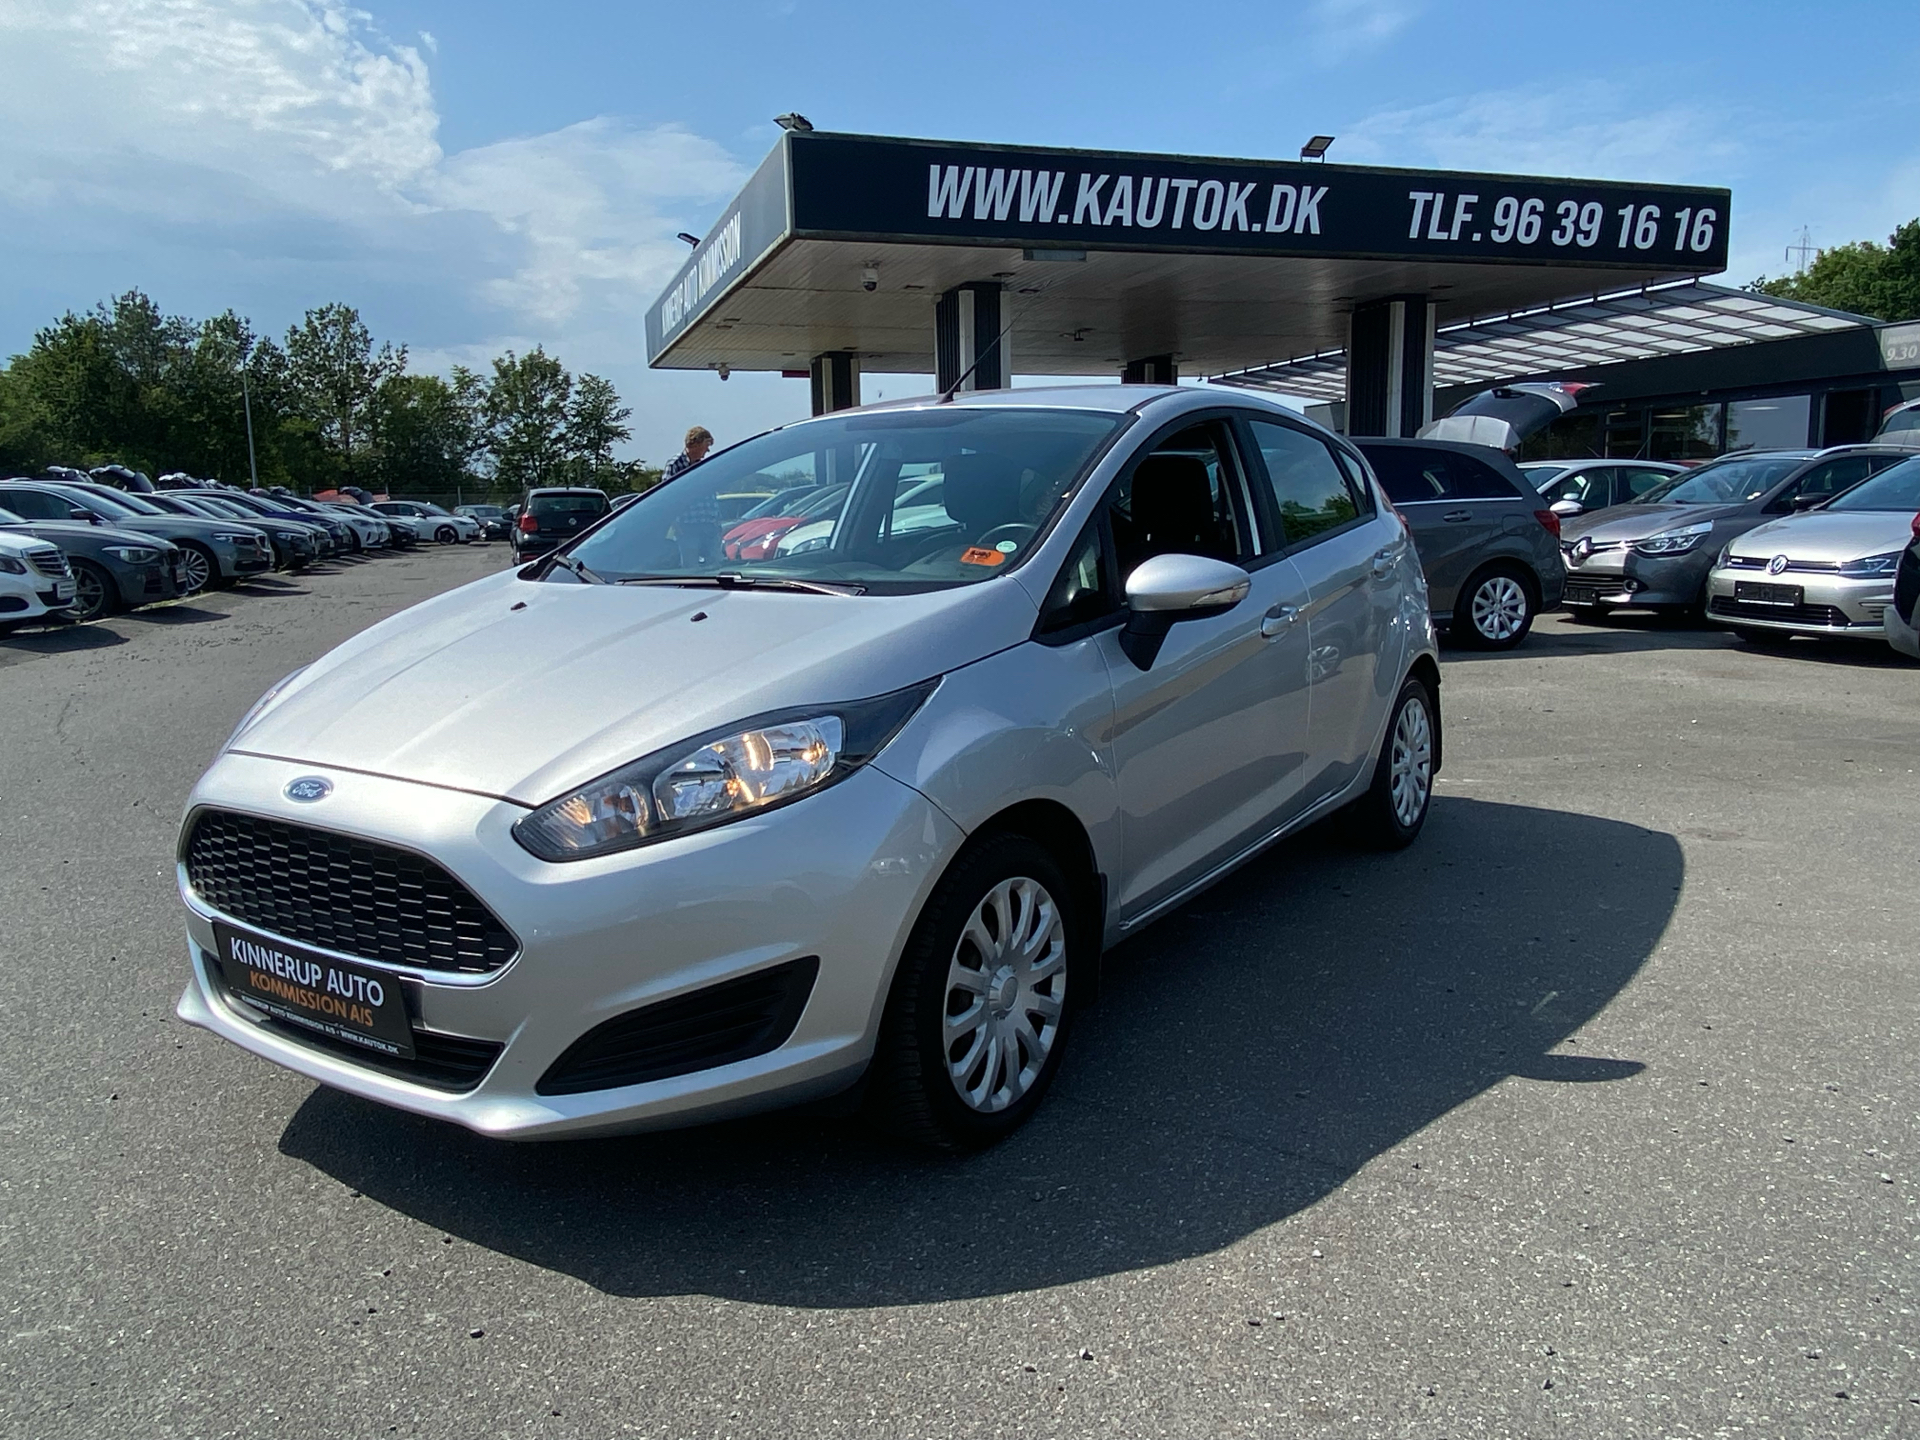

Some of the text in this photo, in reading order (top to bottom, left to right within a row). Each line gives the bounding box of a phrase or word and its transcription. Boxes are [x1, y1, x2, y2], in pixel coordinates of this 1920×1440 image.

[928, 164, 1329, 235] WWW.KAUTOK.DK
[1408, 191, 1717, 253] TLF. 96 39 16 16
[1886, 345, 1918, 361] 9.30
[292, 782, 322, 798] Ford
[230, 937, 385, 1007] KINNERUP AUTO
[250, 970, 347, 1018] KOMMISSION
